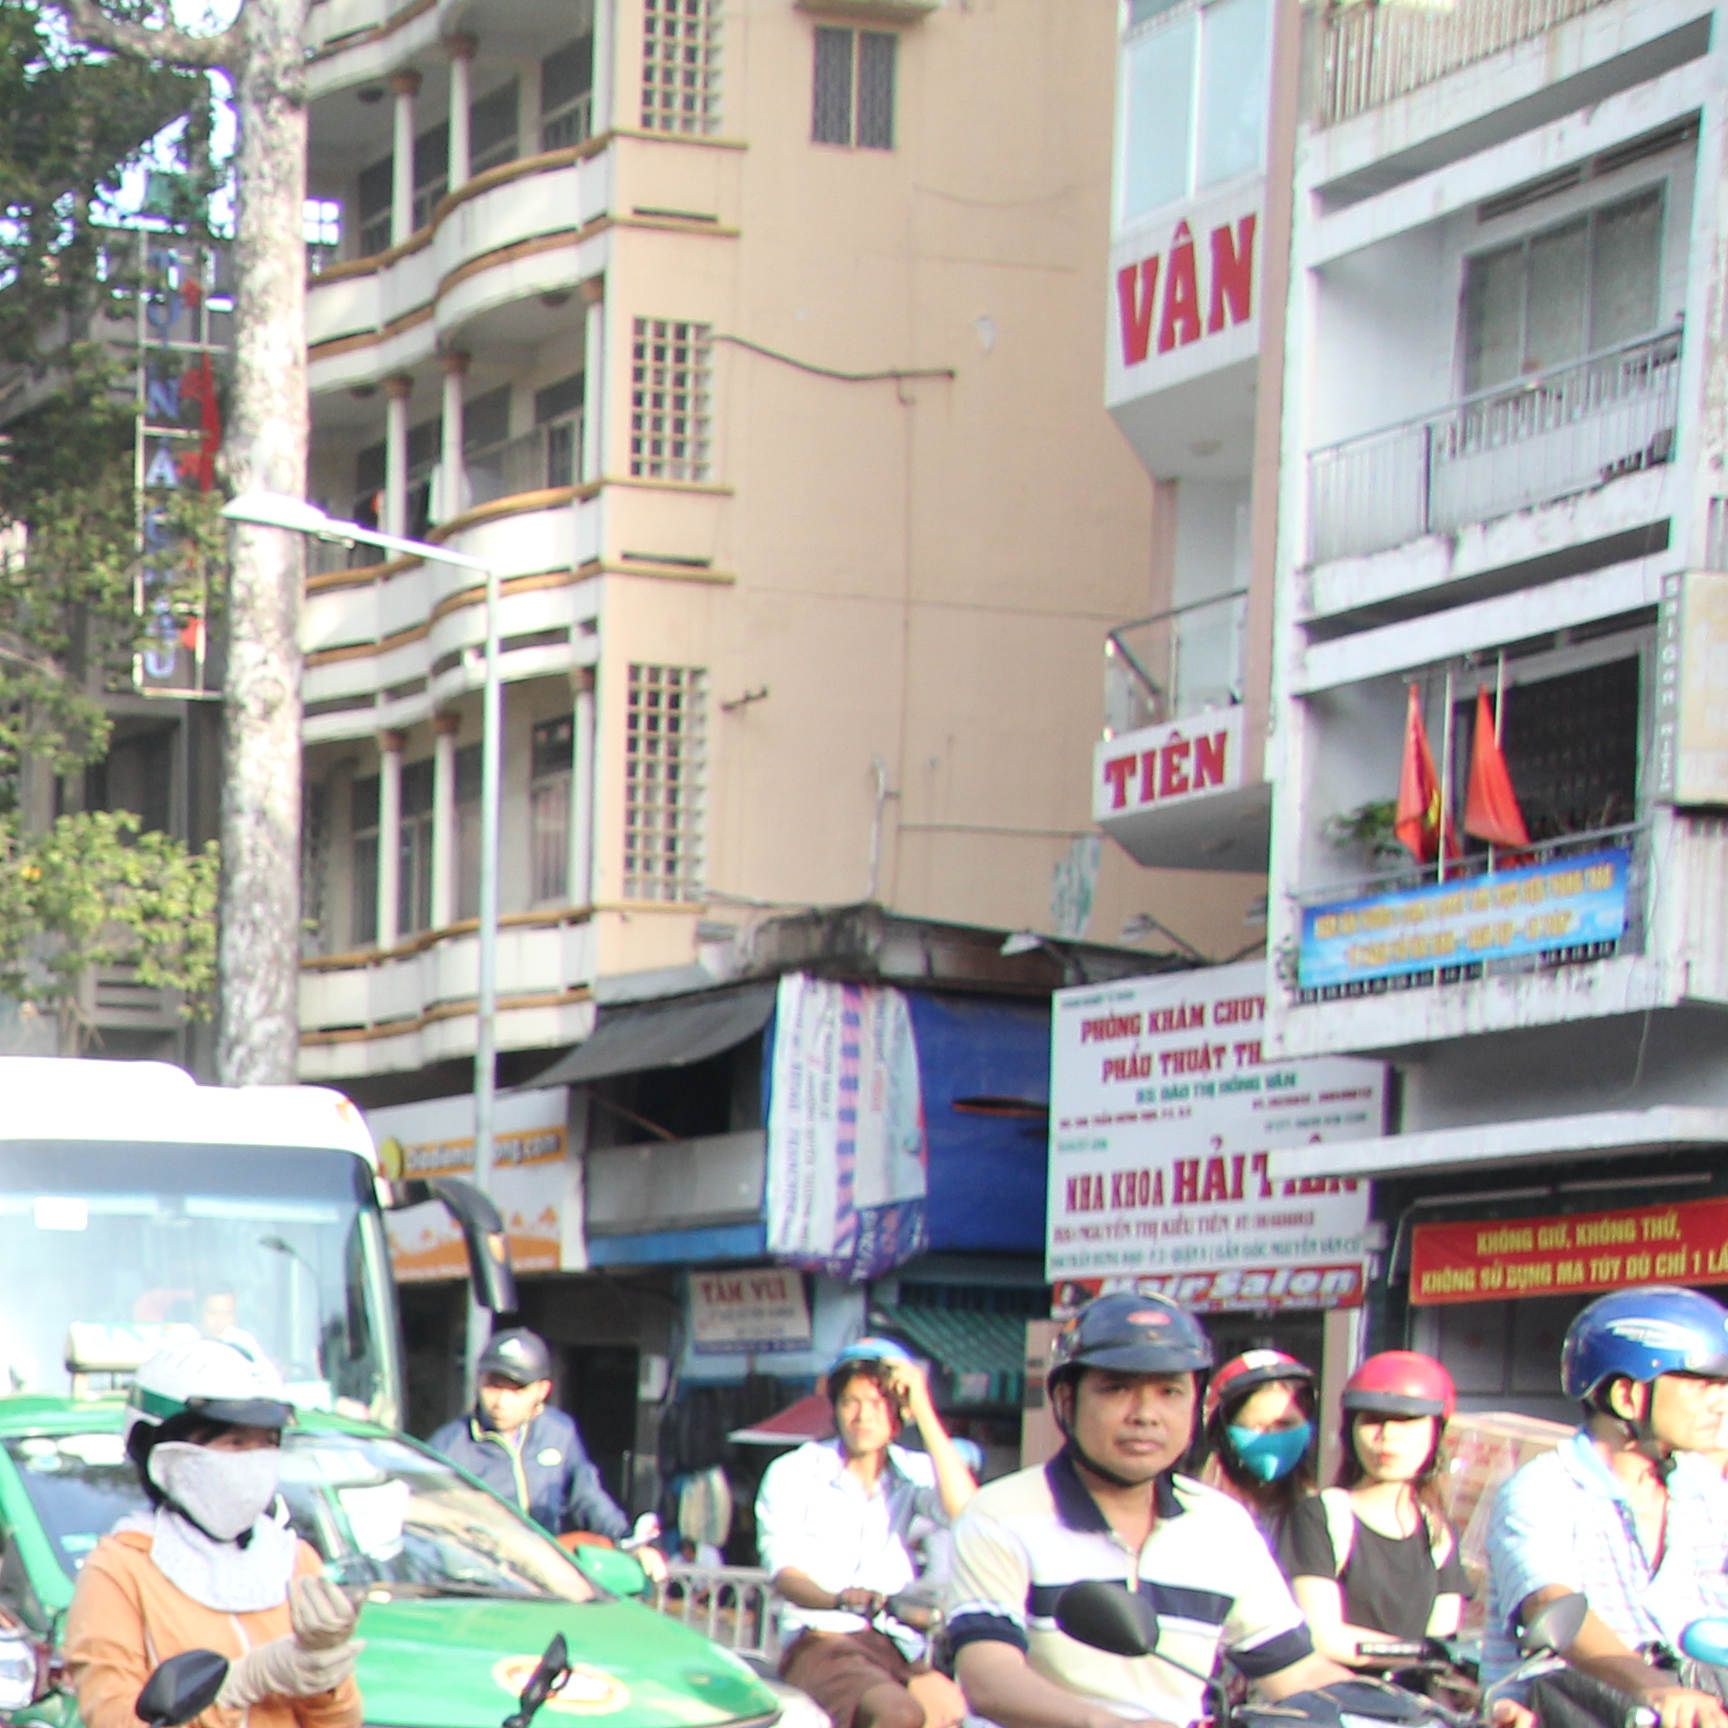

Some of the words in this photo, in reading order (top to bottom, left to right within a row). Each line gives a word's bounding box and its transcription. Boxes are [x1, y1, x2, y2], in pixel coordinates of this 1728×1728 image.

[1117, 214, 1257, 369] VÂN
[1104, 729, 1228, 809] TIÊN
[1080, 1006, 1141, 1044] PHÒNG
[1149, 995, 1204, 1032] KHÁM
[1160, 1042, 1226, 1080] THUẬT
[1066, 1173, 1103, 1213] NHA
[1111, 1167, 1164, 1209] KHOA
[1172, 1134, 1245, 1204] HẢI
[1477, 1228, 1533, 1256] KHÔNG
[1575, 1217, 1637, 1247] KHÔNG
[1211, 1267, 1357, 1302] Salon
[1421, 1263, 1476, 1294] KHÔNG
[1480, 1257, 1503, 1290] SỬ
[1506, 1262, 1552, 1294] DỤNG
[1556, 1260, 1584, 1285] MA
[1590, 1252, 1622, 1282] TÚY
[1655, 1243, 1687, 1278] CHỈ
[1692, 1253, 1701, 1274] 1
